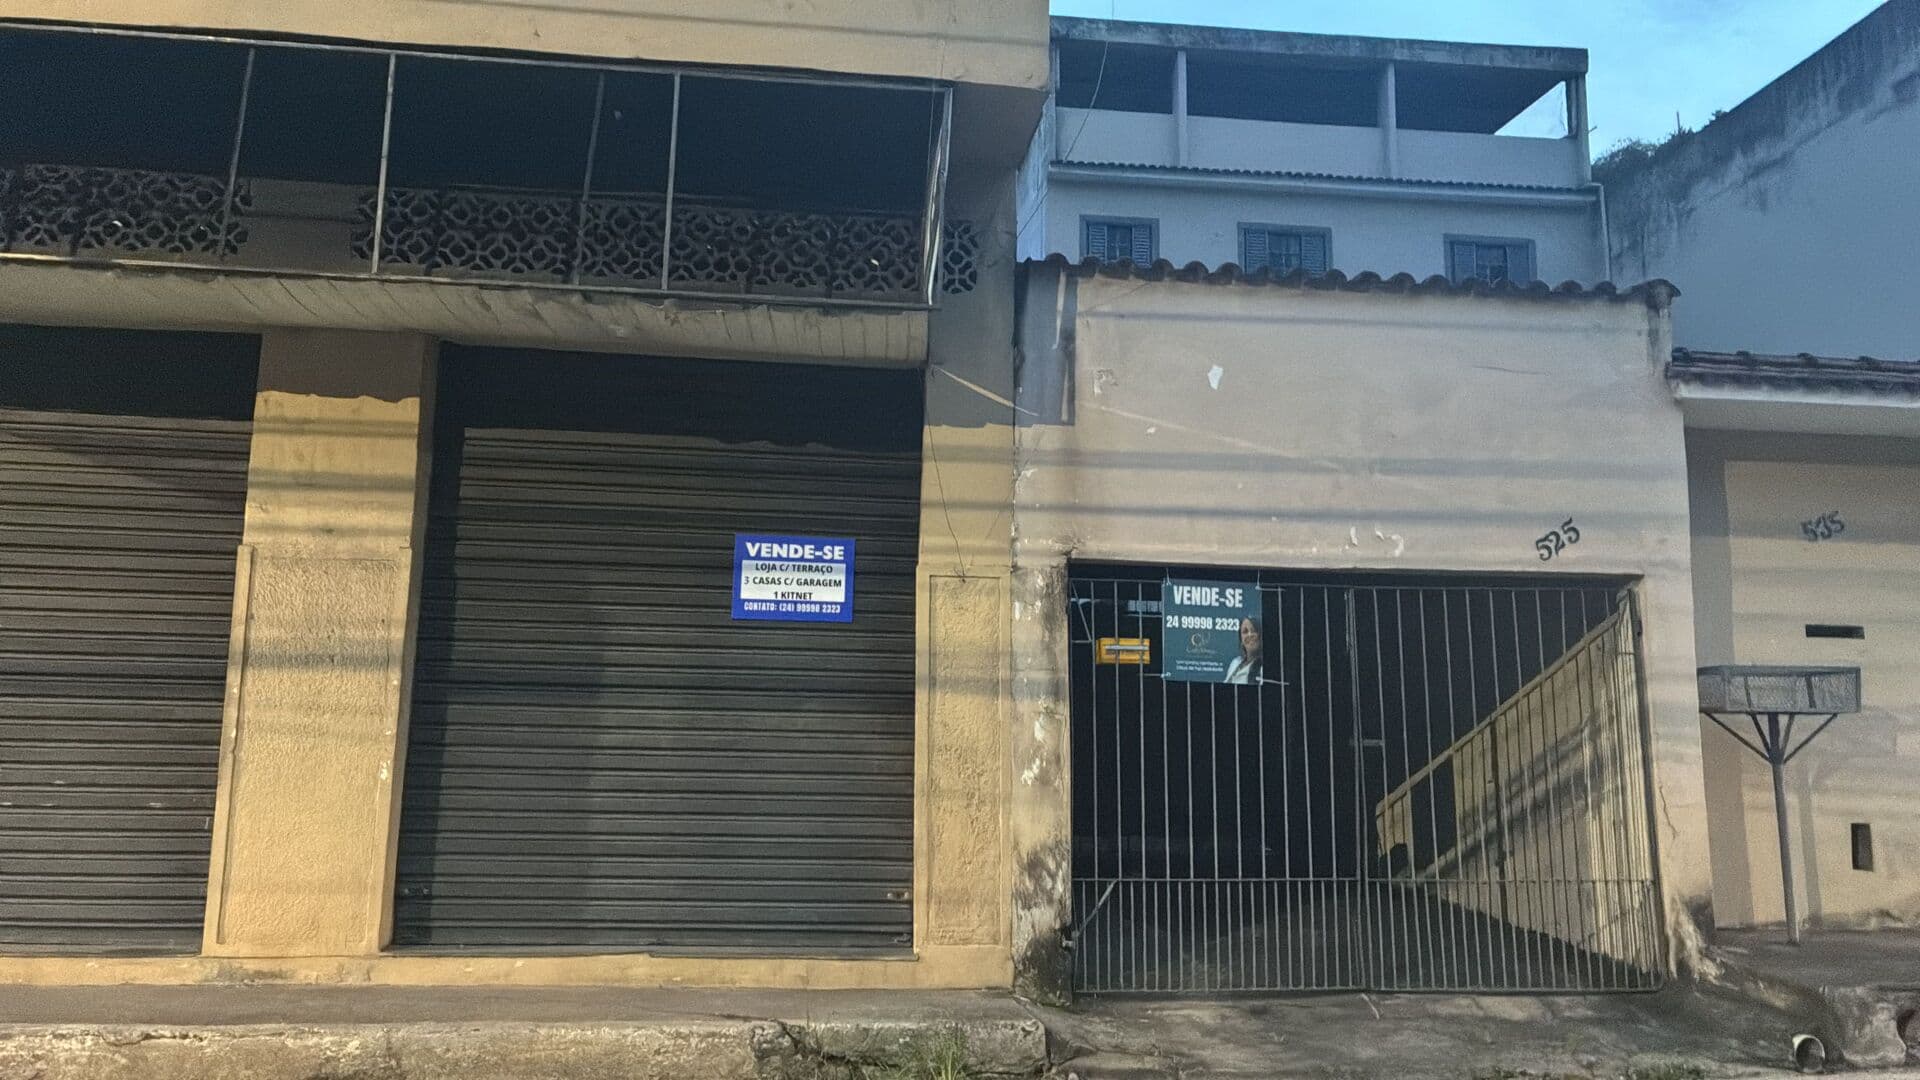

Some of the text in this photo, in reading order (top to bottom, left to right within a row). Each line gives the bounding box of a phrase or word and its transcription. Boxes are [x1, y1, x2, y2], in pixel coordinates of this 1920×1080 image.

[1535, 518, 1581, 561] 525
[745, 542, 845, 560] VENDE-SE
[755, 563, 833, 574] LOJA C/ TERRAÇO
[743, 576, 842, 587] 3 CASAS C/ GARAGEM
[780, 591, 813, 600] KITNET
[1173, 585, 1243, 608] VENDE-SE
[743, 601, 777, 611] CONTATO:
[1166, 615, 1240, 631] 24 99998 2323
